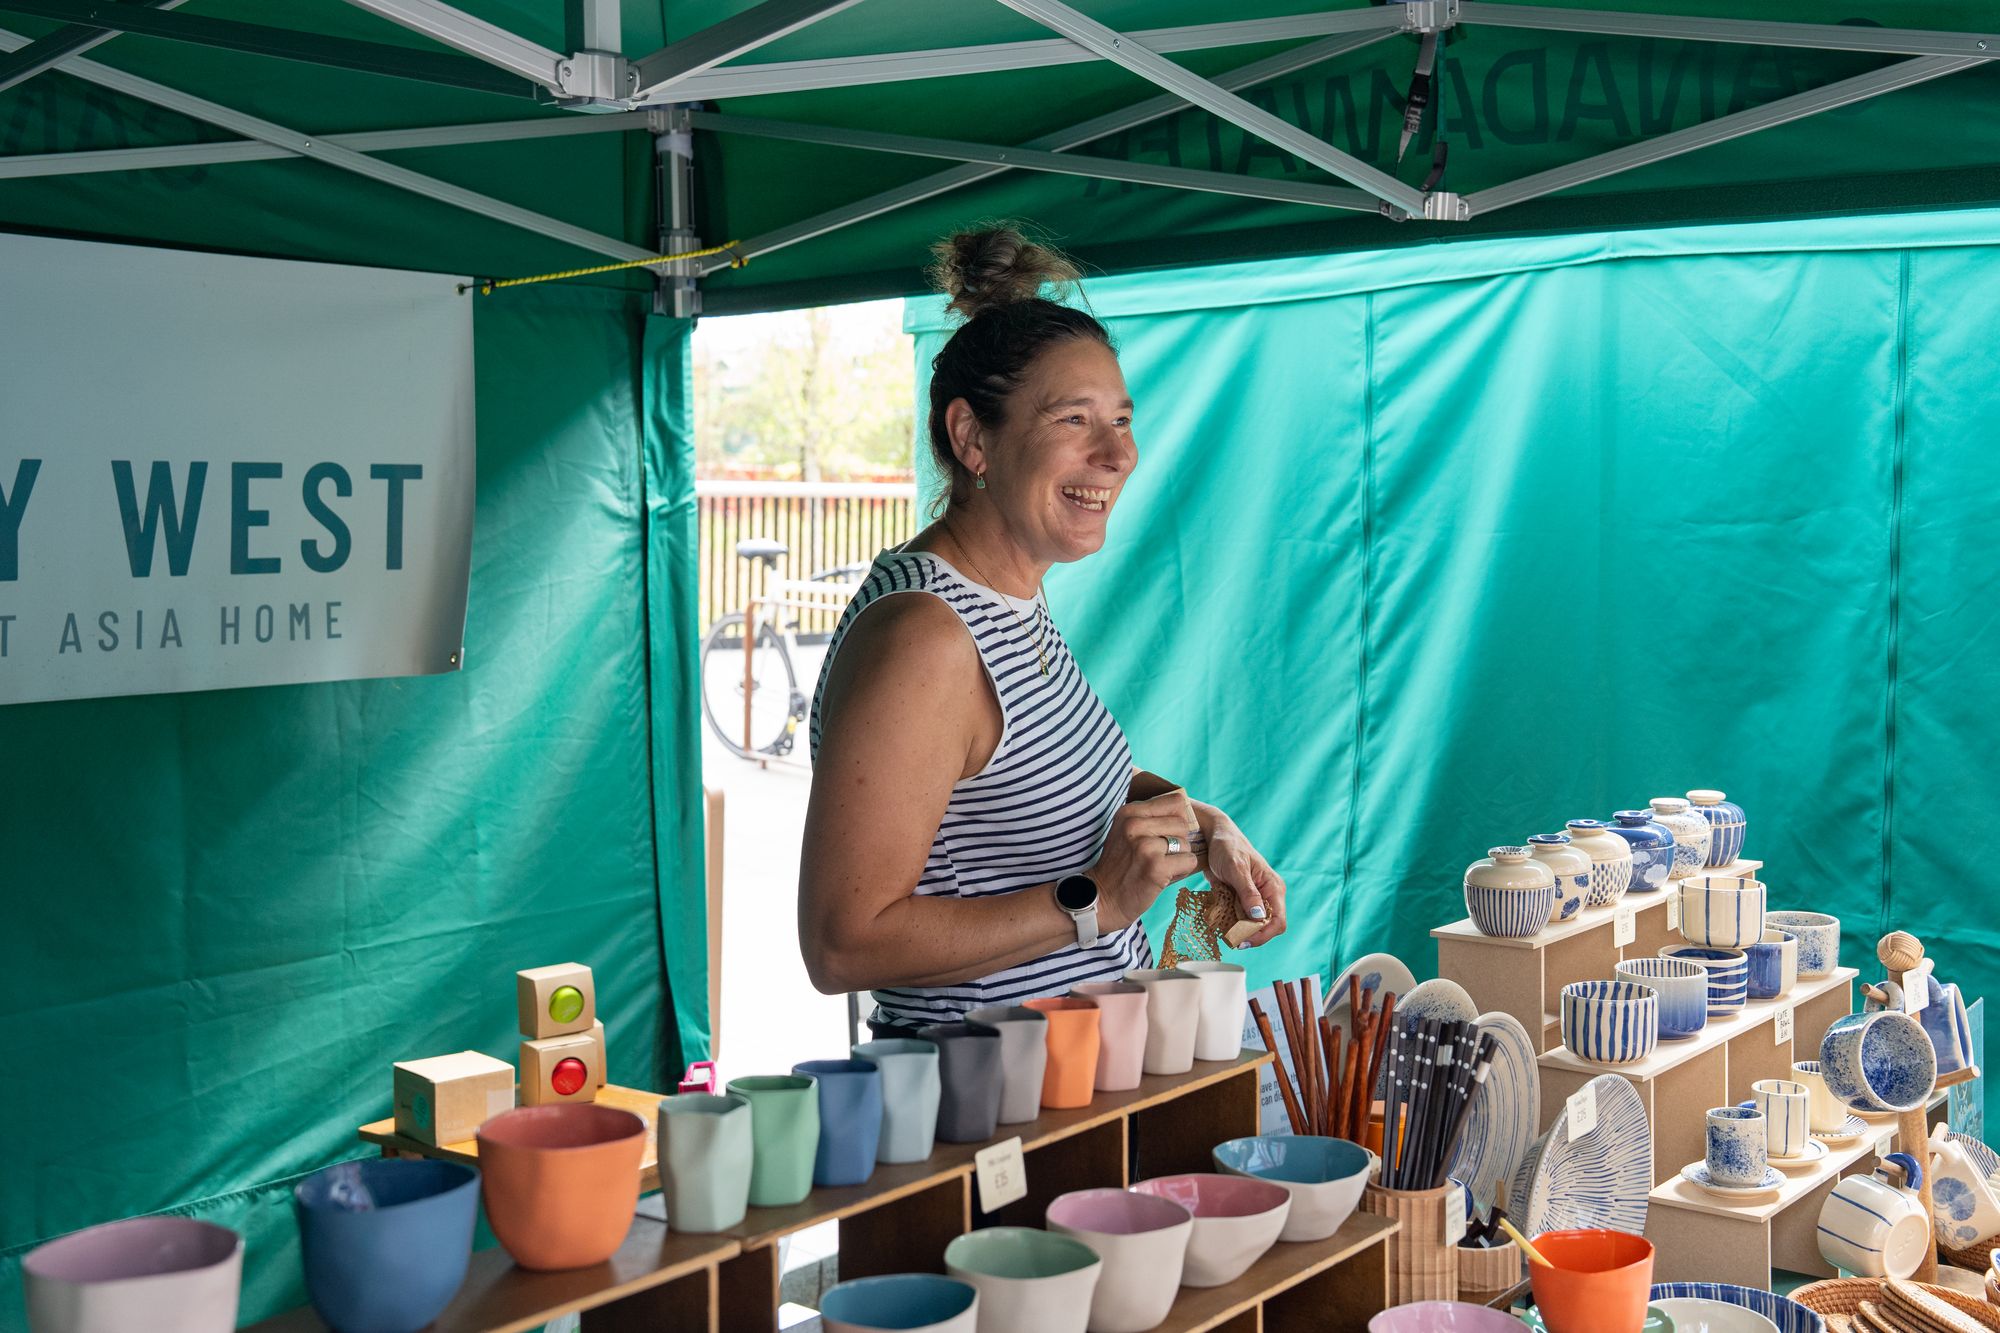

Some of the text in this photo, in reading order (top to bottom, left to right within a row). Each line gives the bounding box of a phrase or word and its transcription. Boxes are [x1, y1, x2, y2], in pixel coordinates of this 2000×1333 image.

[111, 460, 423, 578] WEST
[58, 608, 183, 654] ASIA
[220, 601, 342, 645] HOME
